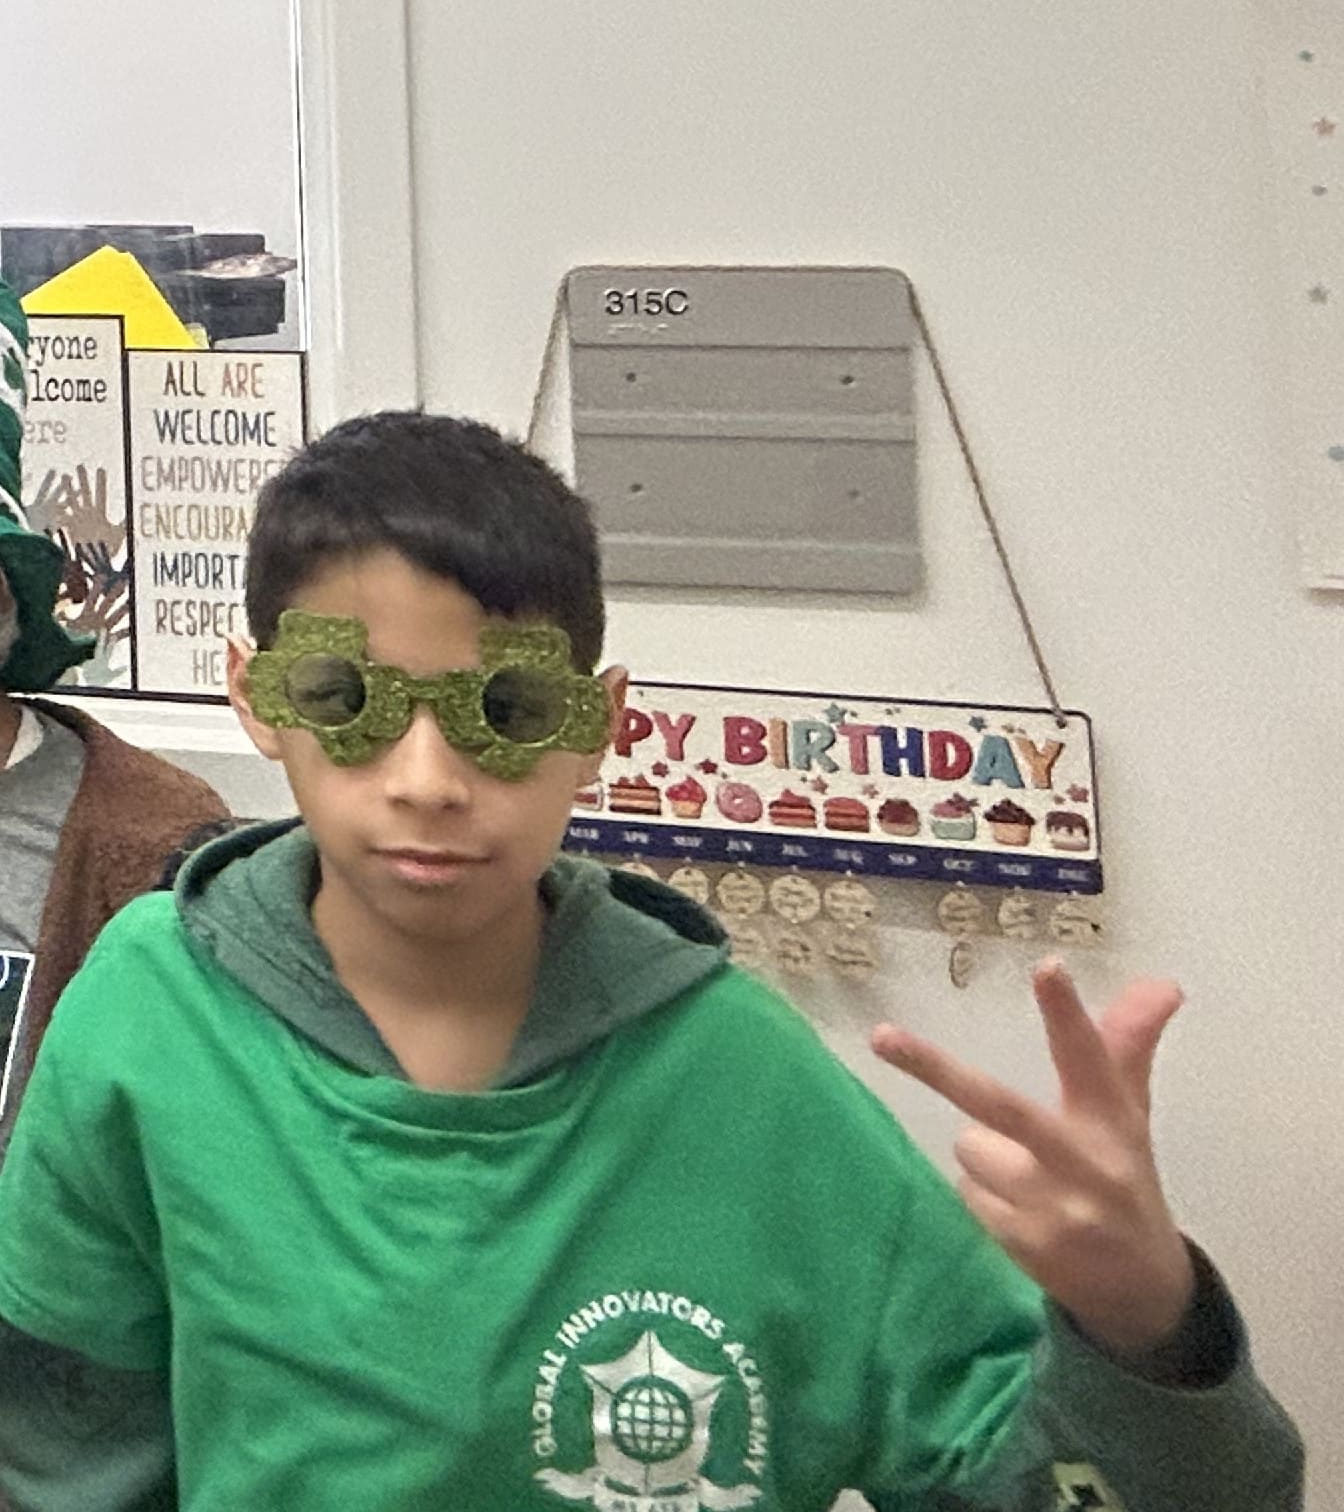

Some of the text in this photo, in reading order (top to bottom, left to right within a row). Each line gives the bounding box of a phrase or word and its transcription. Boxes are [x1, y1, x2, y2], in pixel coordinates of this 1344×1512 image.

[603, 289, 690, 316] 315C
[30, 368, 108, 404] lcome
[163, 360, 265, 399] ALL ARE
[24, 420, 67, 444] ere
[153, 407, 278, 448] WELCOME
[140, 456, 289, 495] EMPOWER
[139, 502, 249, 543] ENCOURA
[152, 550, 248, 590] IMPORT
[155, 598, 246, 638] RESPEC
[192, 649, 224, 686] HE
[722, 715, 1066, 790] BIRTHDAY
[531, 1348, 568, 1457] GLOBAL
[554, 1289, 726, 1350] INNOVATORS
